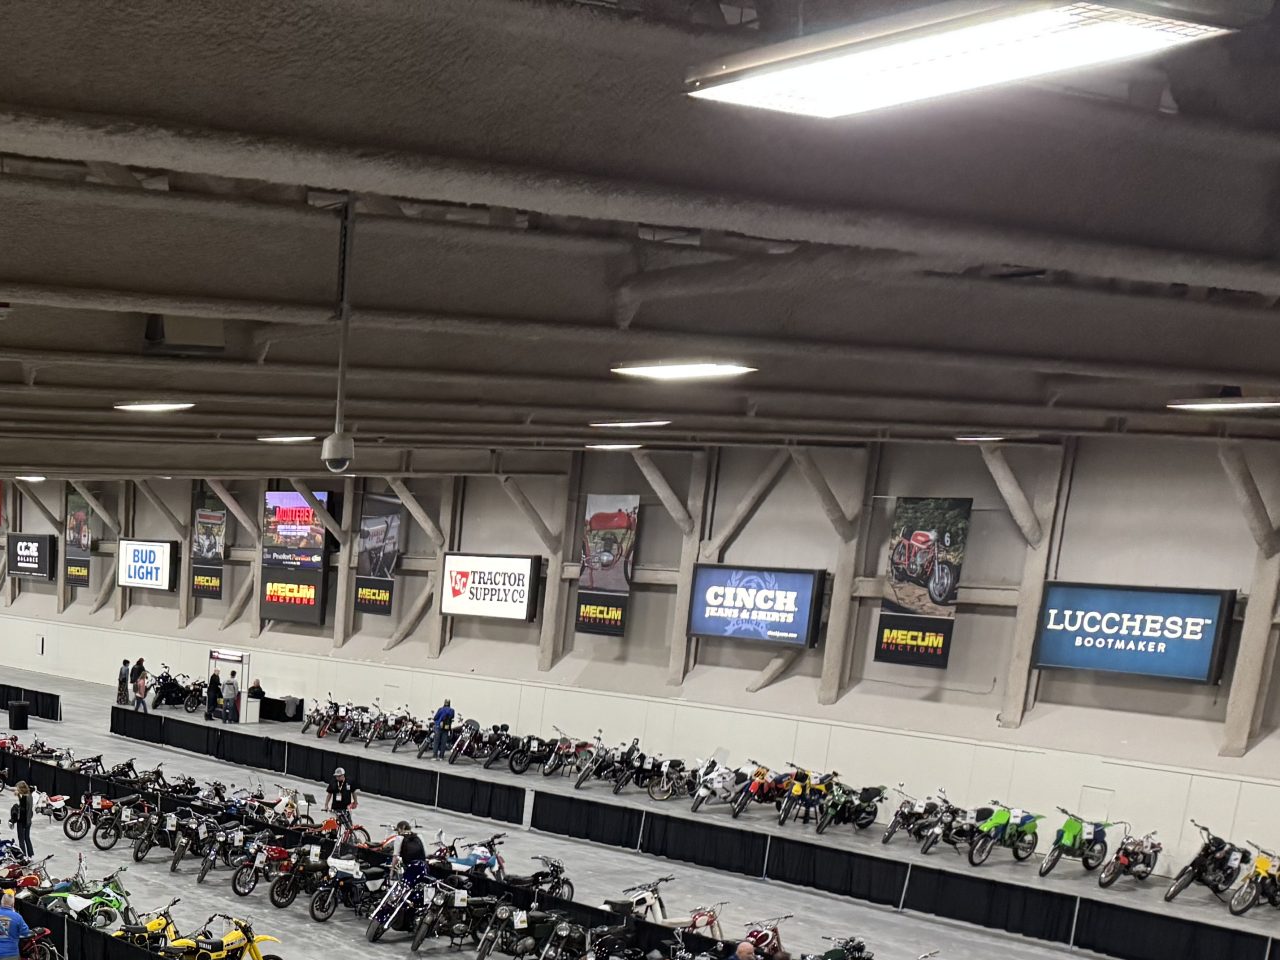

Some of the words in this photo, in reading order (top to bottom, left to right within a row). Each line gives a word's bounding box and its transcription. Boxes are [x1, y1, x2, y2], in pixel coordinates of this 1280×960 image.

[275, 506, 314, 521] MONTEREY
[133, 548, 156, 566] BUD
[128, 564, 160, 582] LIGHT
[471, 571, 525, 587] TRACTOR
[194, 576, 220, 587] MECUM
[451, 571, 467, 594] TSC
[266, 583, 315, 599] MECUM
[358, 588, 389, 601] MECUM
[469, 587, 510, 602] SUPPLY
[705, 585, 797, 611] CINCH
[266, 595, 316, 606] AUCTIONS
[580, 604, 622, 620] MECUM
[705, 607, 739, 618] JEANS
[740, 609, 750, 619] &
[751, 610, 794, 622] SHIRTS
[579, 617, 621, 626] AUCTIONS
[882, 628, 944, 648] MECUM
[1075, 636, 1166, 653] BOOTMAKER
[881, 643, 942, 655] AUCTIONS
